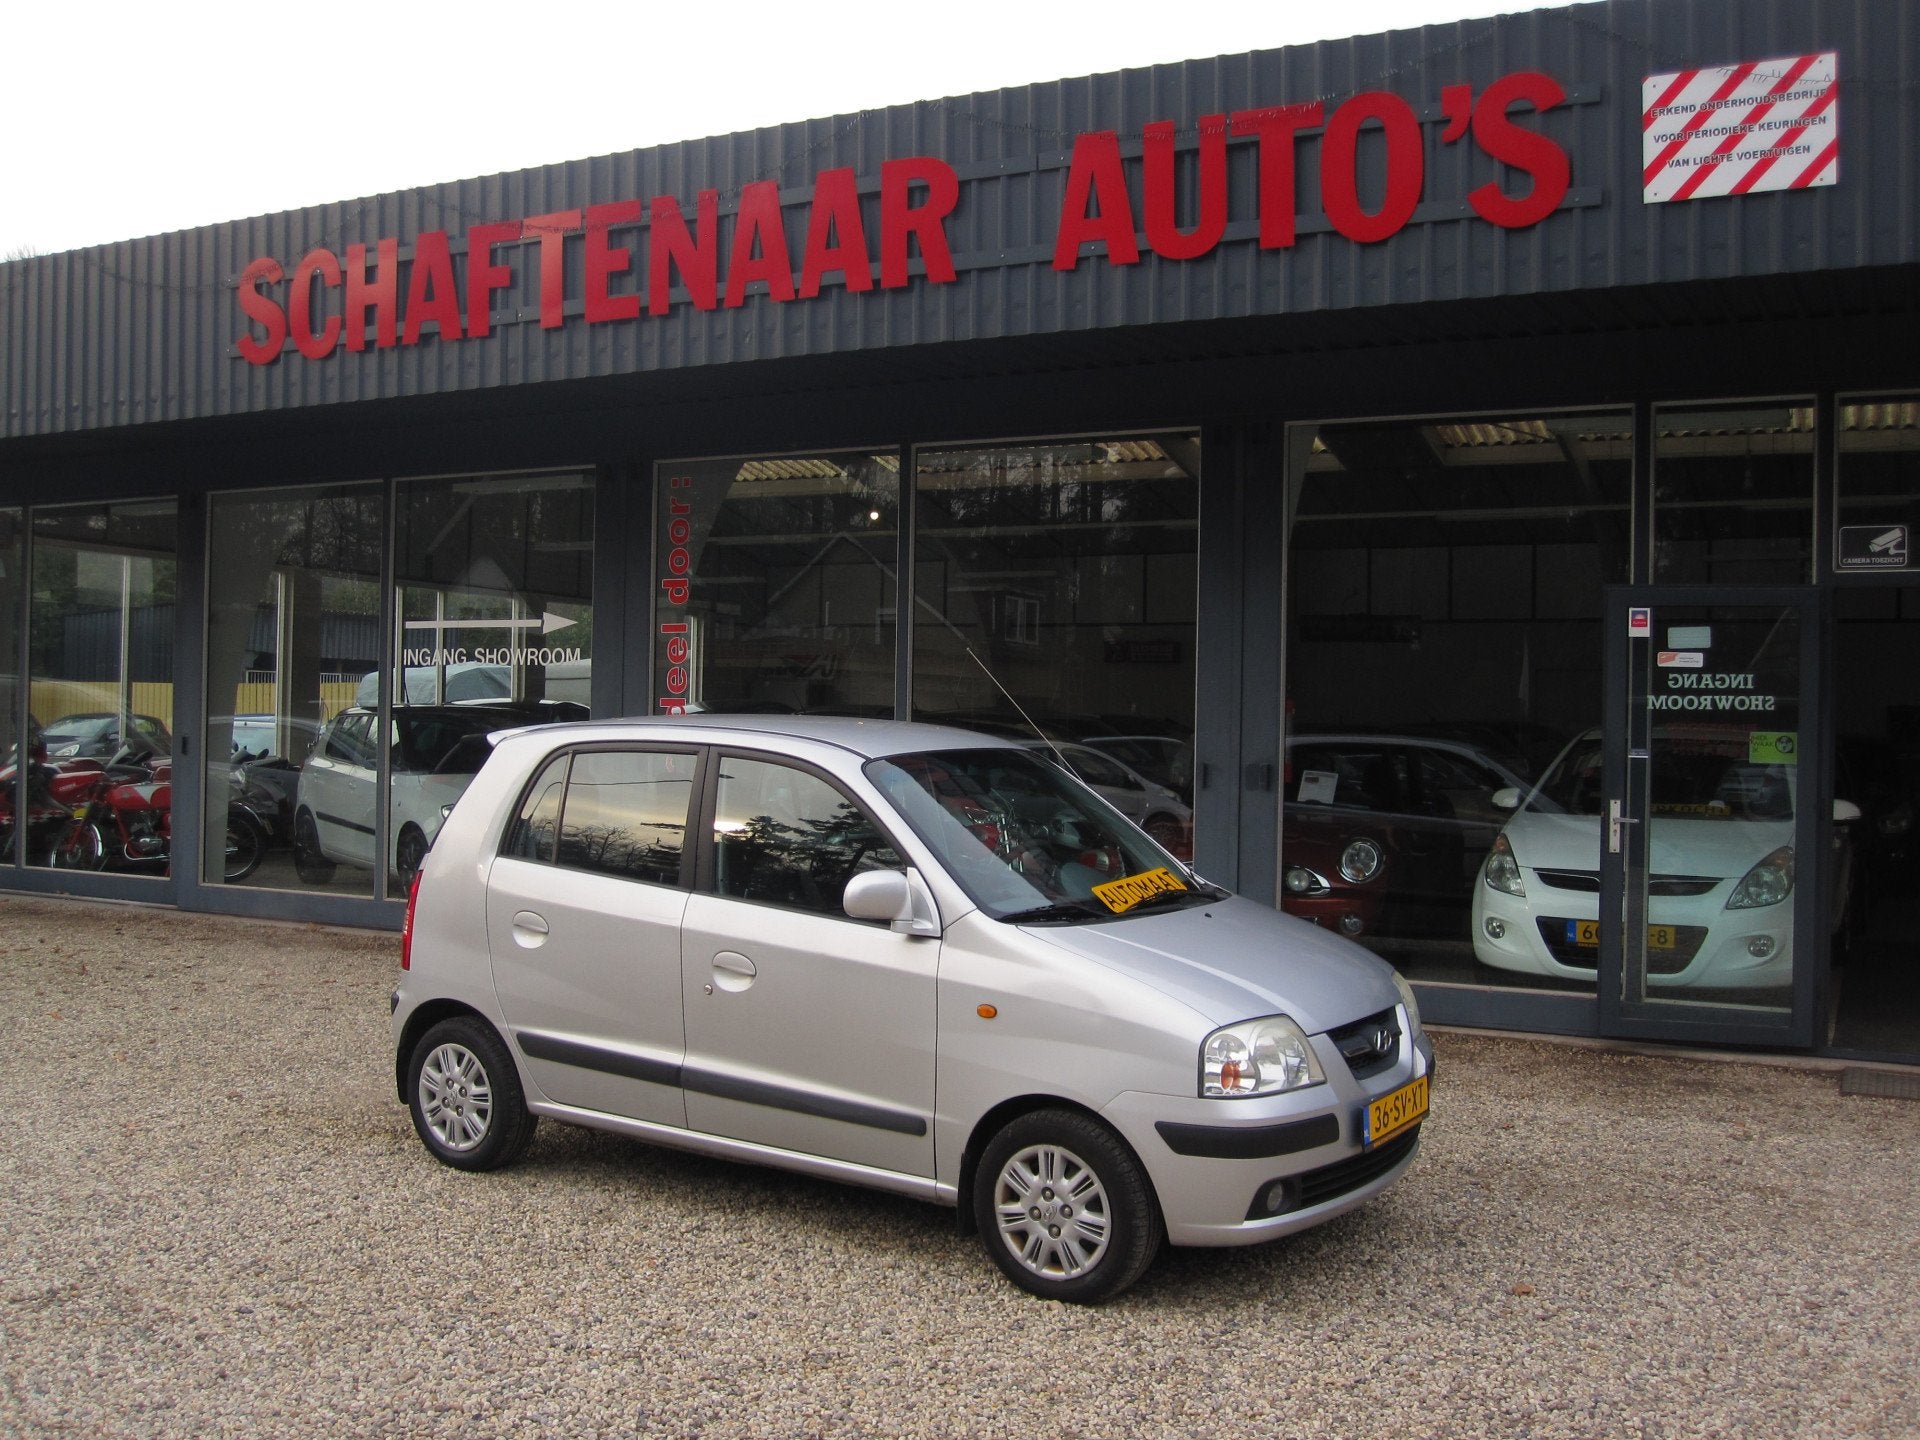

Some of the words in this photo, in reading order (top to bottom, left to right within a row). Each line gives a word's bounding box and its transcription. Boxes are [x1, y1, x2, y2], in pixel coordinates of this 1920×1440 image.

[1651, 104, 1697, 118] ERKEND
[1700, 87, 1827, 112] ONDERHOUDSBEDRIJF
[1653, 132, 1685, 144] VOOR
[1687, 124, 1755, 140] PERIODIEKE
[1758, 115, 1827, 132] KEURINGEN
[1667, 157, 1690, 169] VAN
[1692, 152, 1733, 166] LICHTE
[1736, 144, 1811, 162] VOERTUIGEN
[236, 156, 959, 365] SCHAFTENAAR
[1053, 71, 1571, 271] AUTO'S
[403, 648, 467, 666] INGANG
[473, 647, 581, 666] SHOWROOM
[1100, 871, 1182, 909] AUTOMAAT
[1374, 1081, 1424, 1133] 36-SV-XT
